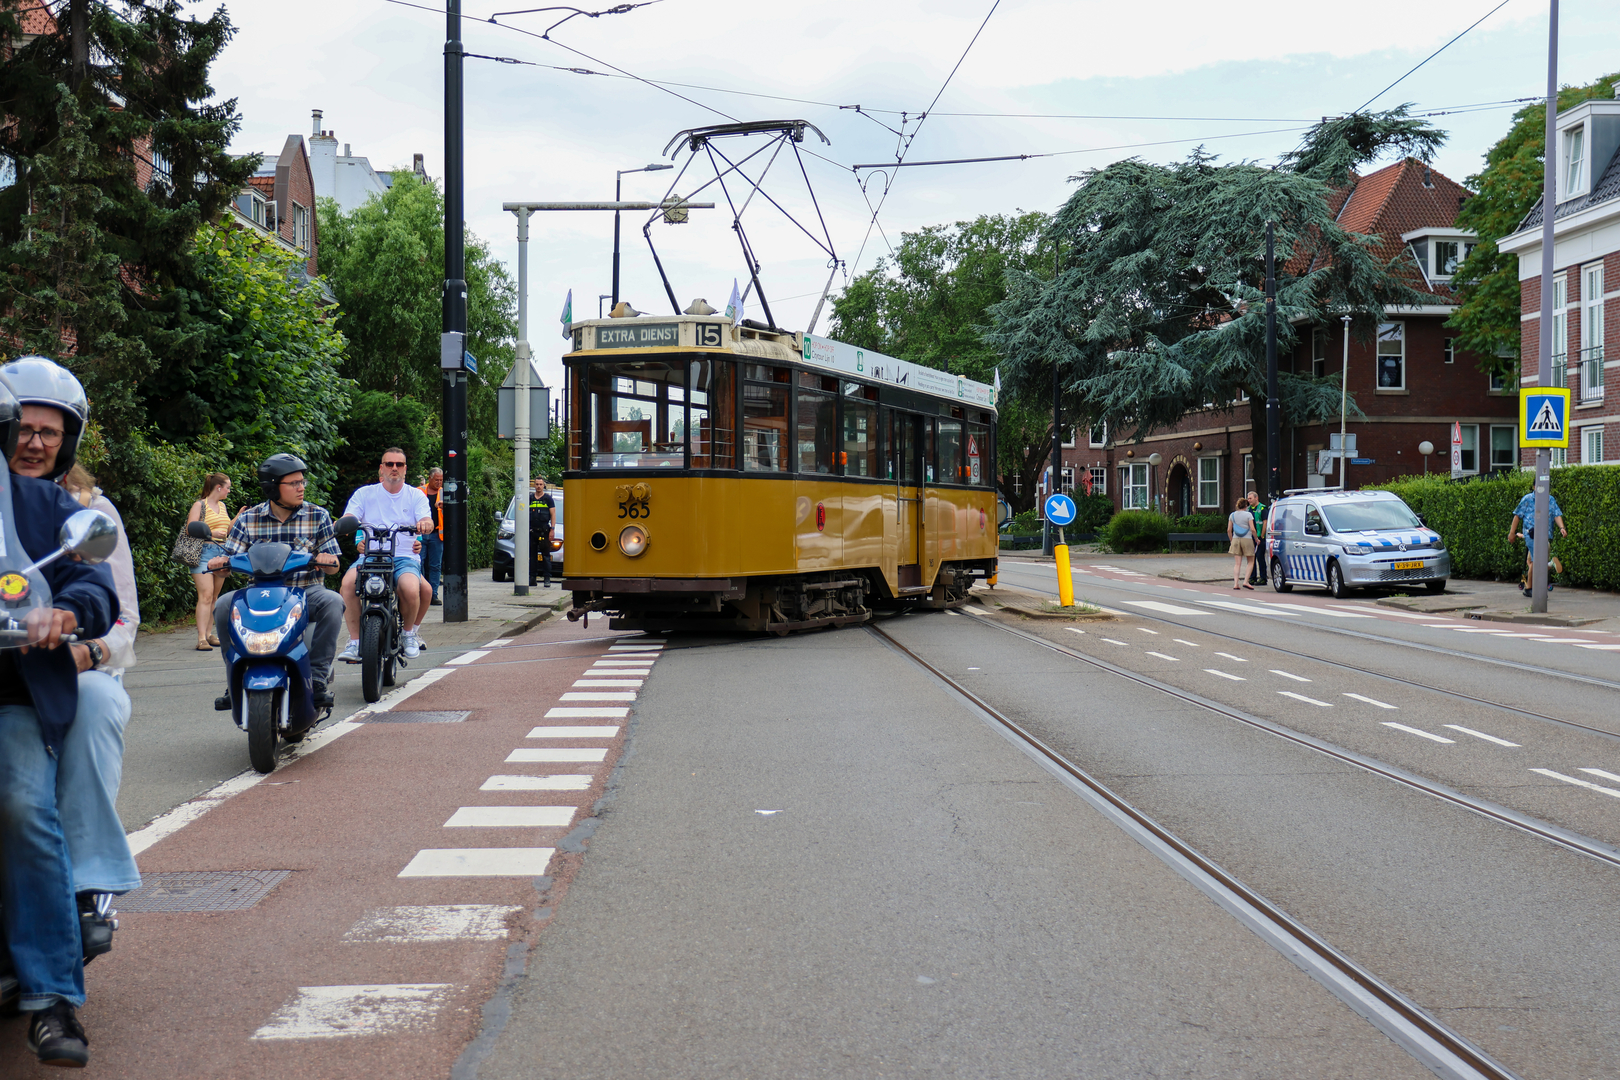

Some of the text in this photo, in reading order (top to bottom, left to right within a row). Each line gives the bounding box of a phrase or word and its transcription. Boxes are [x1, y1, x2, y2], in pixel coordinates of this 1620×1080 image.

[601, 327, 678, 343] EXTRA DIENST
[697, 325, 720, 346] 15
[804, 341, 811, 356] 10
[617, 502, 650, 519] 565
